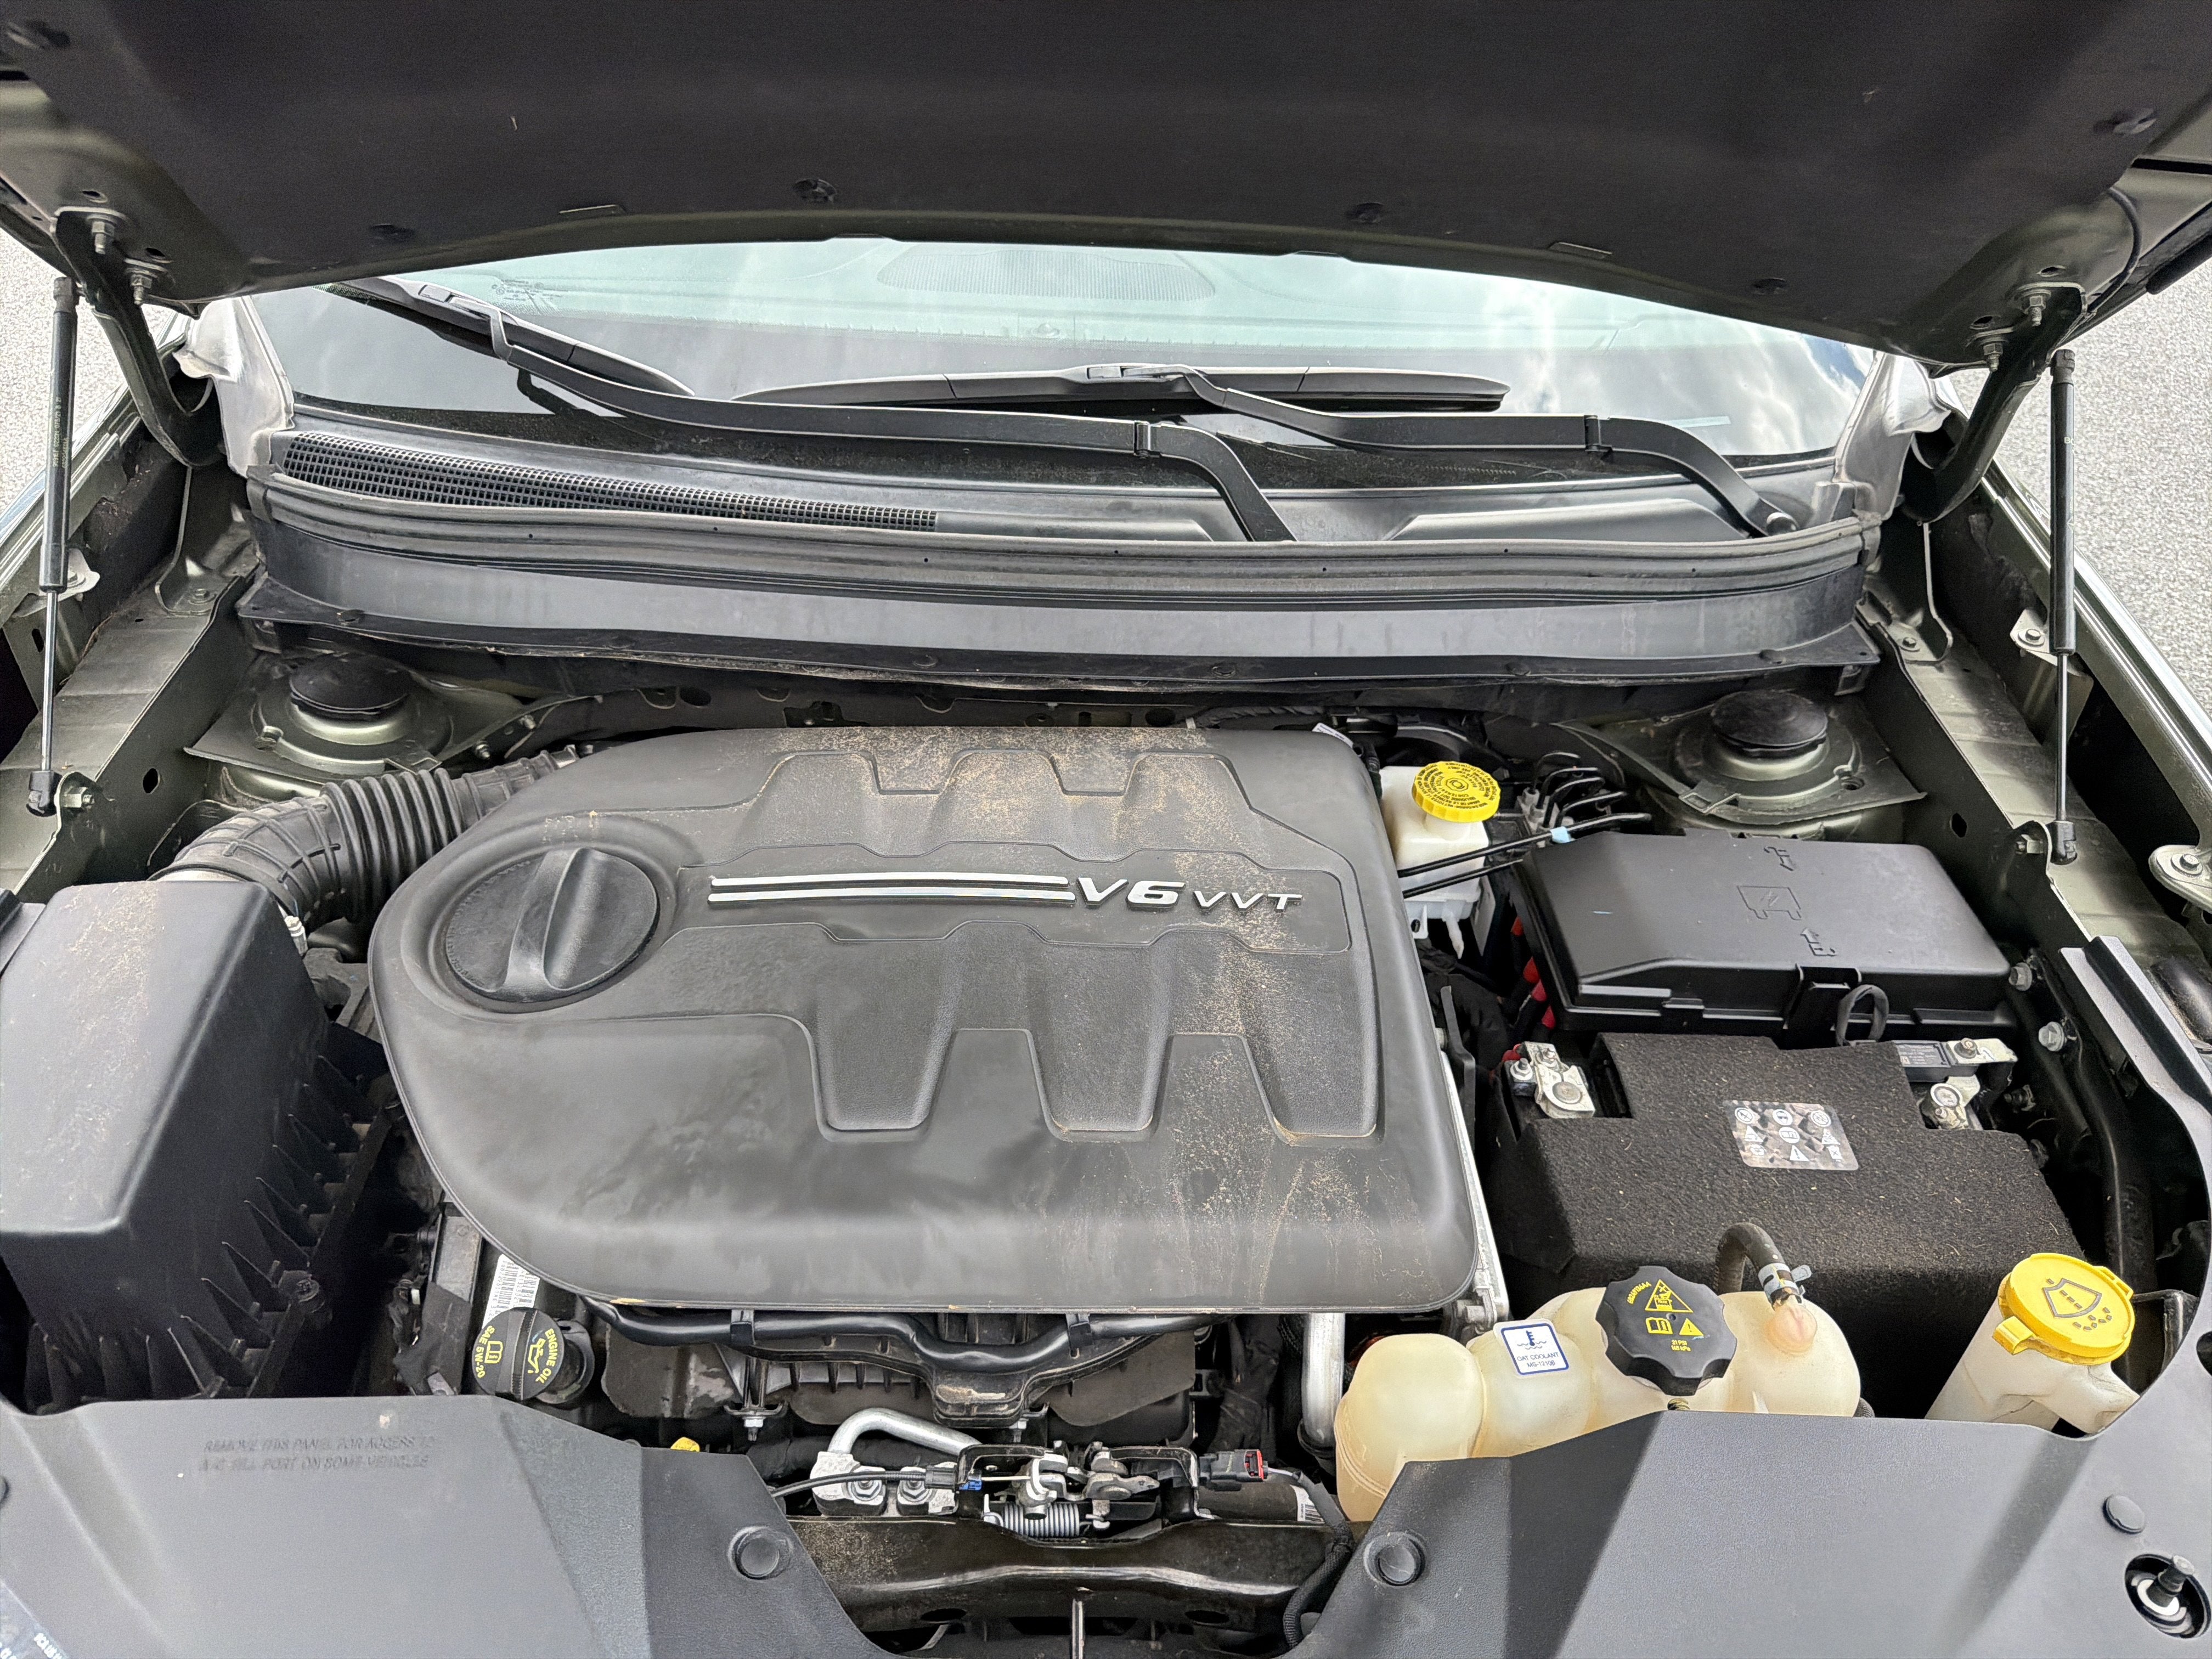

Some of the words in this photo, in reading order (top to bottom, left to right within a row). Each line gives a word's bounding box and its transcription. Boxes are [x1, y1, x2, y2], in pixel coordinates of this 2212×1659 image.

[1076, 876, 1186, 907] V6
[1193, 890, 1303, 913] VVT
[478, 1325, 495, 1345] SAE
[545, 1328, 558, 1367] ENGINE
[475, 1346, 486, 1378] 5W-20
[1530, 1352, 1559, 1361] COOLANT
[535, 1368, 552, 1384] OIL
